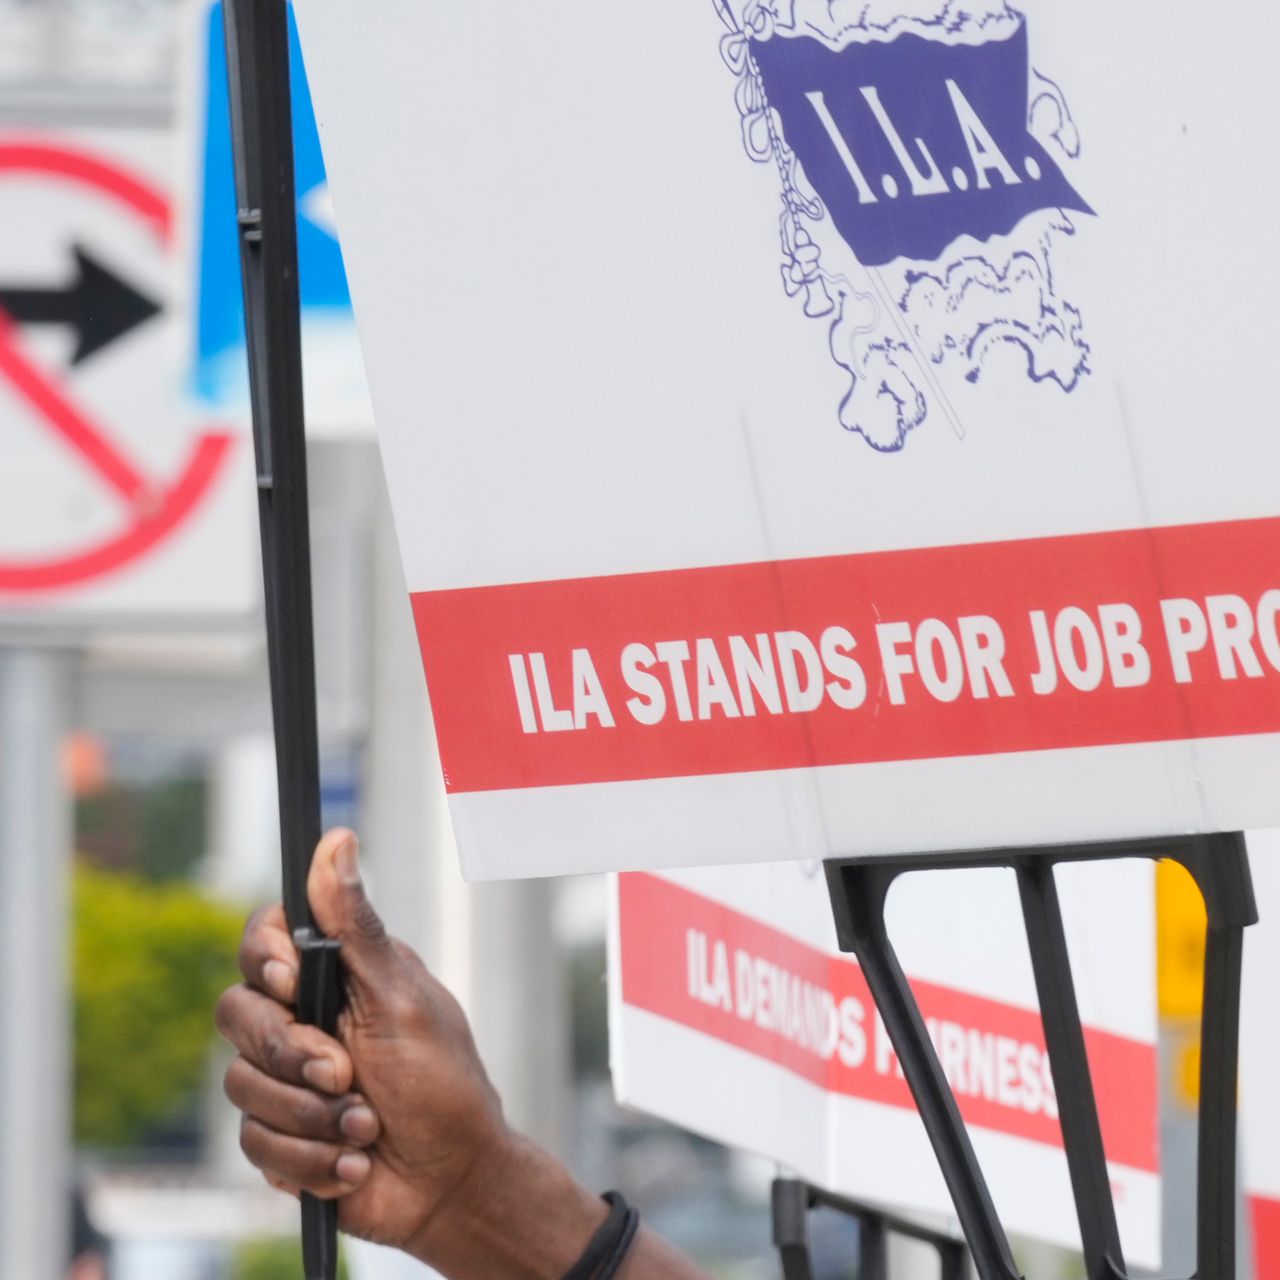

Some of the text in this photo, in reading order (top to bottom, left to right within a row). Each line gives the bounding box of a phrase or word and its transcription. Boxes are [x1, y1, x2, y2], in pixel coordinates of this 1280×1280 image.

[805, 78, 1042, 205] I.L.A.
[507, 647, 616, 734] ILA
[619, 625, 867, 725] STANDS
[874, 613, 1015, 706] FOR
[1028, 602, 1151, 695] JOB
[686, 927, 733, 1013] ILA
[734, 947, 866, 1069] DEMANDS
